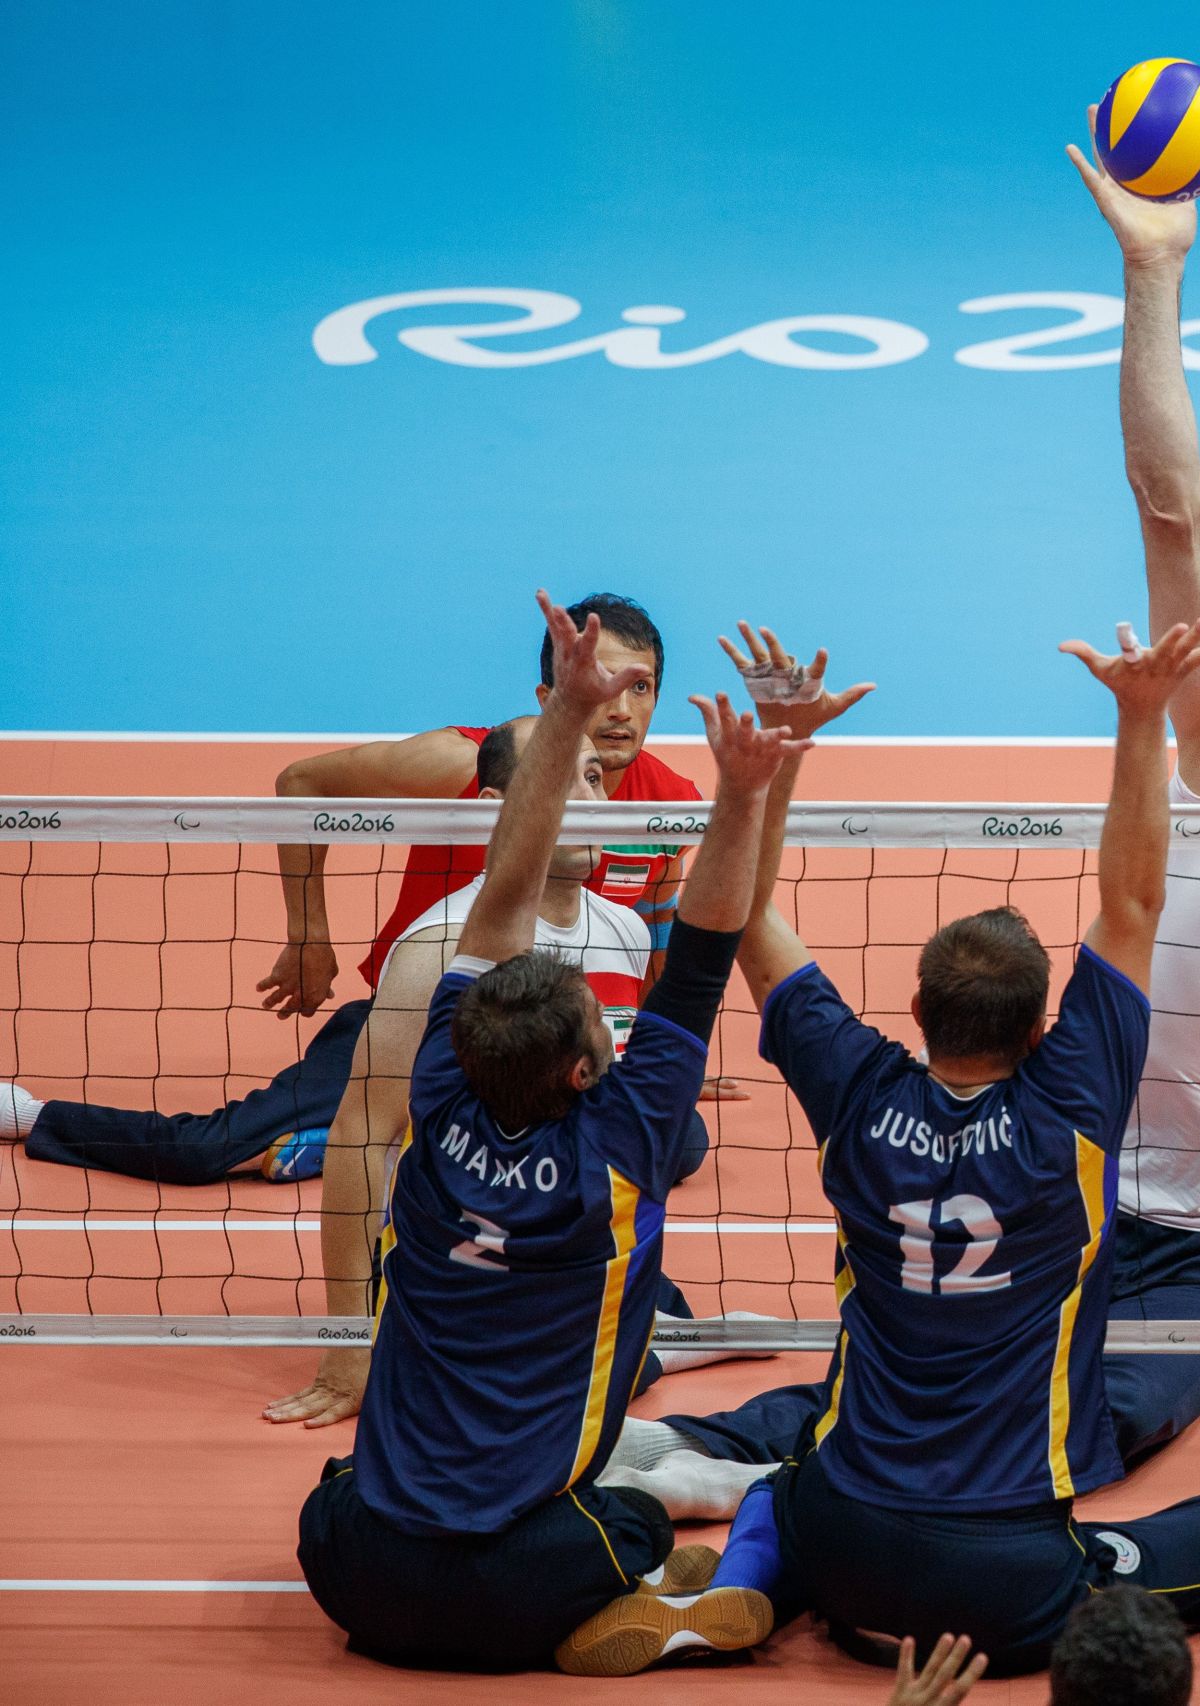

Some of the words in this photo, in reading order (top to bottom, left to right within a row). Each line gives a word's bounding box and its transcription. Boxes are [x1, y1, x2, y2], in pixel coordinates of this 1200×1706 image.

[0, 810, 61, 829] io2016
[313, 812, 395, 832] Rio2016
[646, 816, 707, 833] Rio20
[982, 817, 1063, 836] Rio2016
[449, 1208, 511, 1272] 2
[888, 1194, 1012, 1296] 12
[0, 1324, 36, 1336] o2016
[318, 1327, 369, 1340] Rio2016
